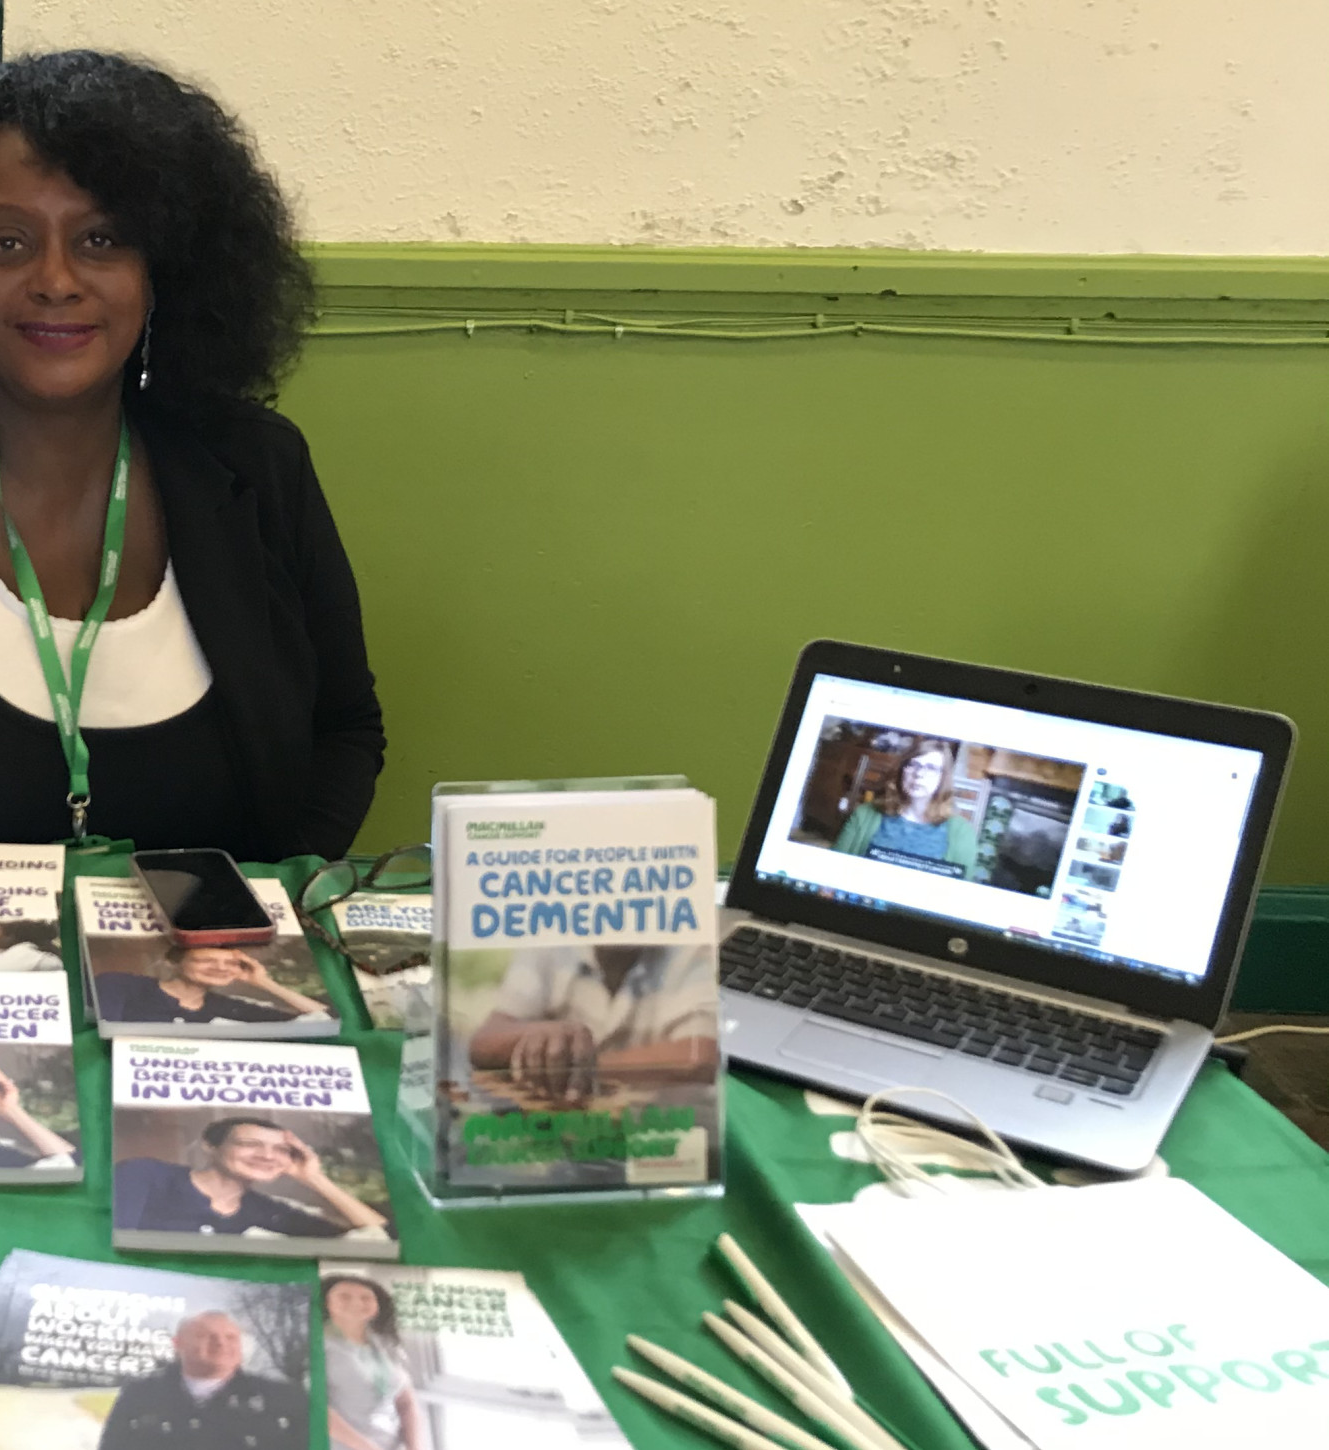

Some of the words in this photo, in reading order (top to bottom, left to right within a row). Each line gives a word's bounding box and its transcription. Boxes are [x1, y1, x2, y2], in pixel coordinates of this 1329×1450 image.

[465, 850, 480, 866] A
[482, 849, 541, 866] GUIDE
[545, 848, 581, 864] FOR
[584, 846, 647, 863] PEOPLE
[652, 845, 699, 860] WITH
[478, 867, 614, 898] CANCER
[622, 864, 696, 893] AND
[98, 917, 133, 931] IN
[471, 895, 700, 940] DEMENTIA
[129, 1057, 354, 1079] UNDERSTANDING
[133, 1067, 237, 1086] BREAST
[241, 1074, 355, 1092] CANCER
[131, 1081, 171, 1099] IN
[179, 1085, 333, 1108] WOMEN
[29, 1298, 148, 1327] ABOUT
[393, 1291, 508, 1312] CANCER
[24, 1331, 82, 1350] WHEN
[86, 1339, 124, 1352] YOU
[27, 1316, 174, 1344] WORKING
[20, 1346, 156, 1374] CANCER?
[979, 1339, 1128, 1379] FULL
[1123, 1323, 1197, 1358] OF
